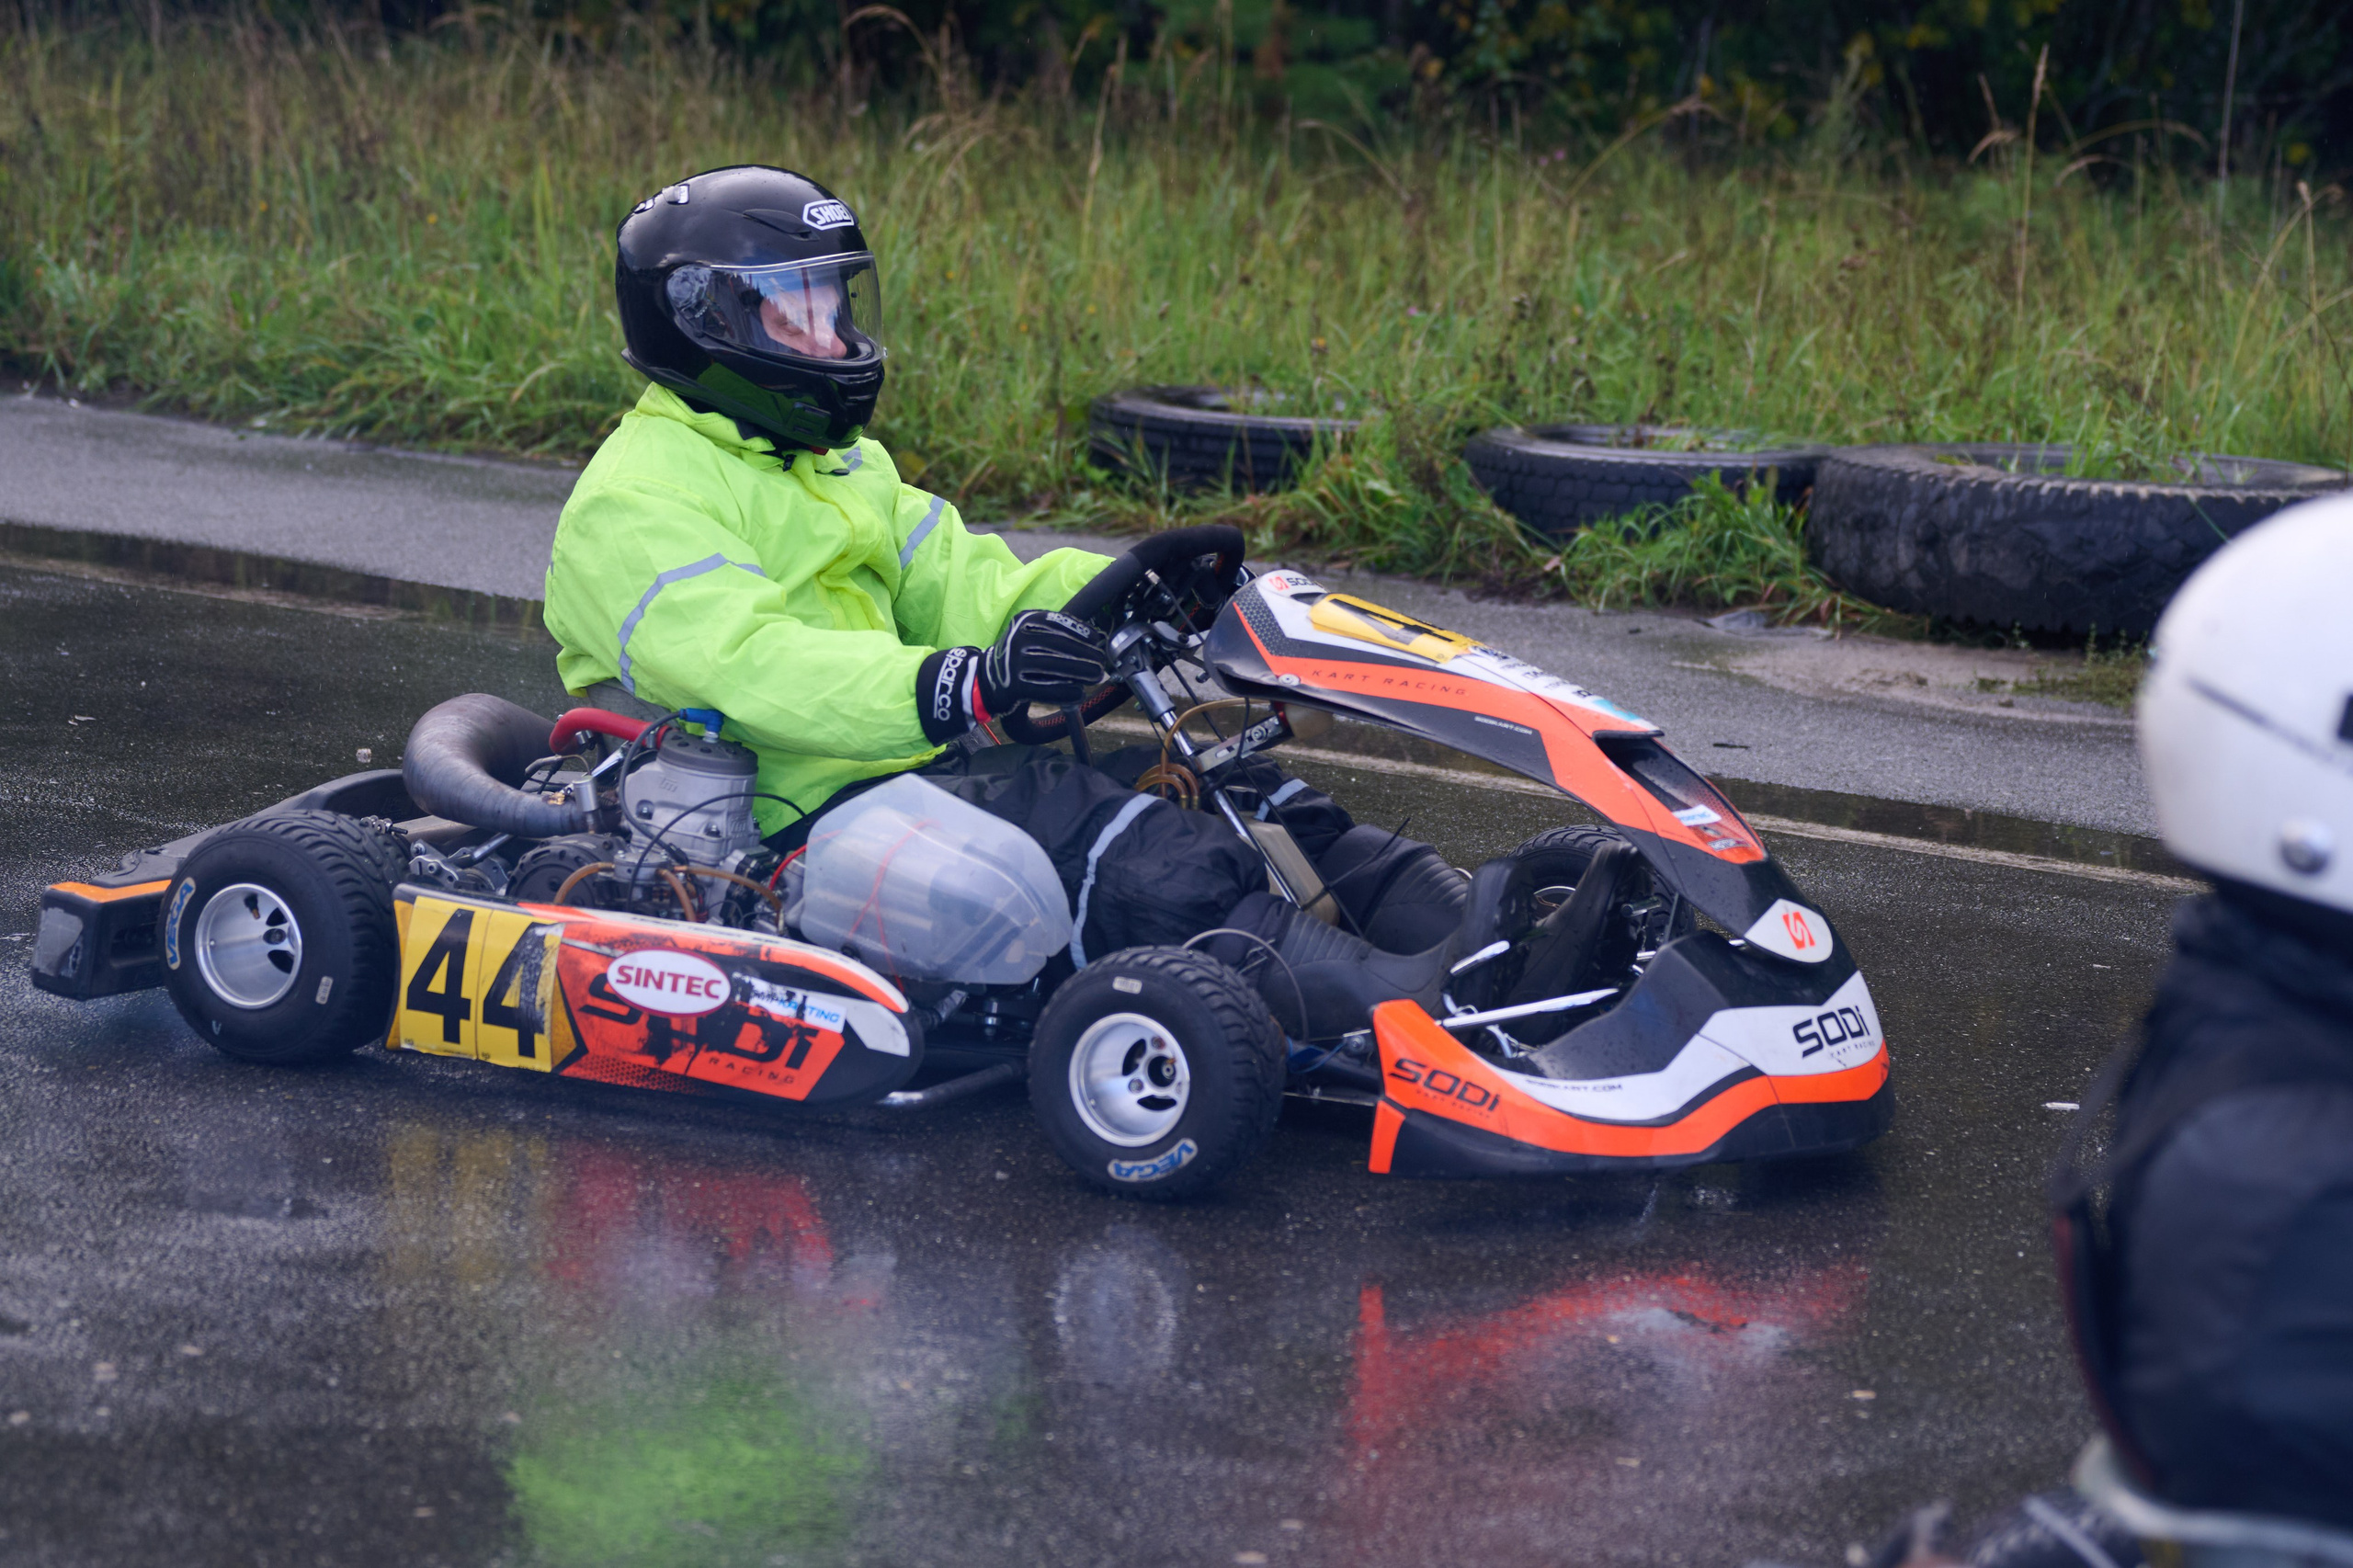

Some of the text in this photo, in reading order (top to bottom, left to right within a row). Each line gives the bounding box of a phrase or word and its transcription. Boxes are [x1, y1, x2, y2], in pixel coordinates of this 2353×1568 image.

[1046, 612, 1090, 638] sparco
[936, 647, 968, 722] sparco
[1312, 669, 1467, 695] KART RACING
[166, 882, 195, 965] VEGA
[406, 908, 545, 1059] 44
[616, 965, 722, 999] SINTEC
[709, 1056, 795, 1085] RACING
[1113, 1142, 1194, 1179] VEGA
